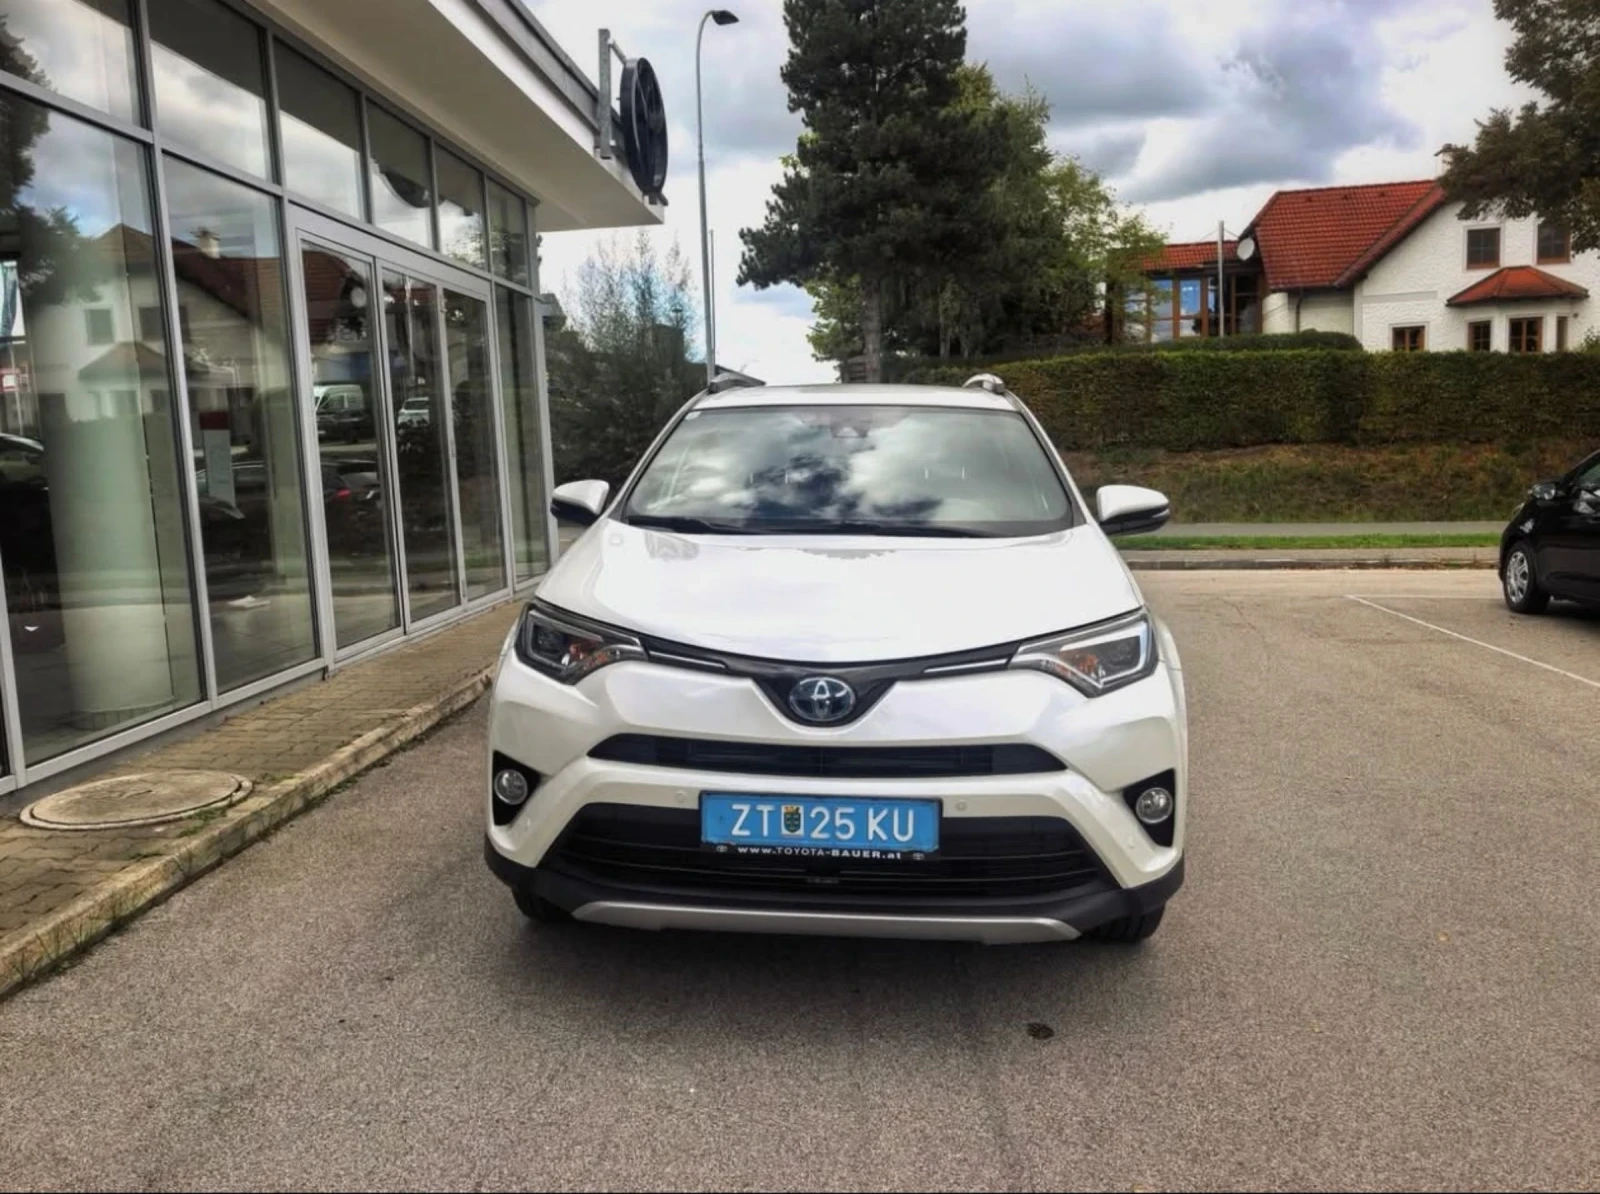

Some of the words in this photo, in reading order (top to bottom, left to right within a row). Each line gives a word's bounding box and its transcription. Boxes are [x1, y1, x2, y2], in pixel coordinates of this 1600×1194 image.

[731, 804, 774, 837] ZT
[809, 806, 855, 840] 25
[867, 807, 914, 842] KU
